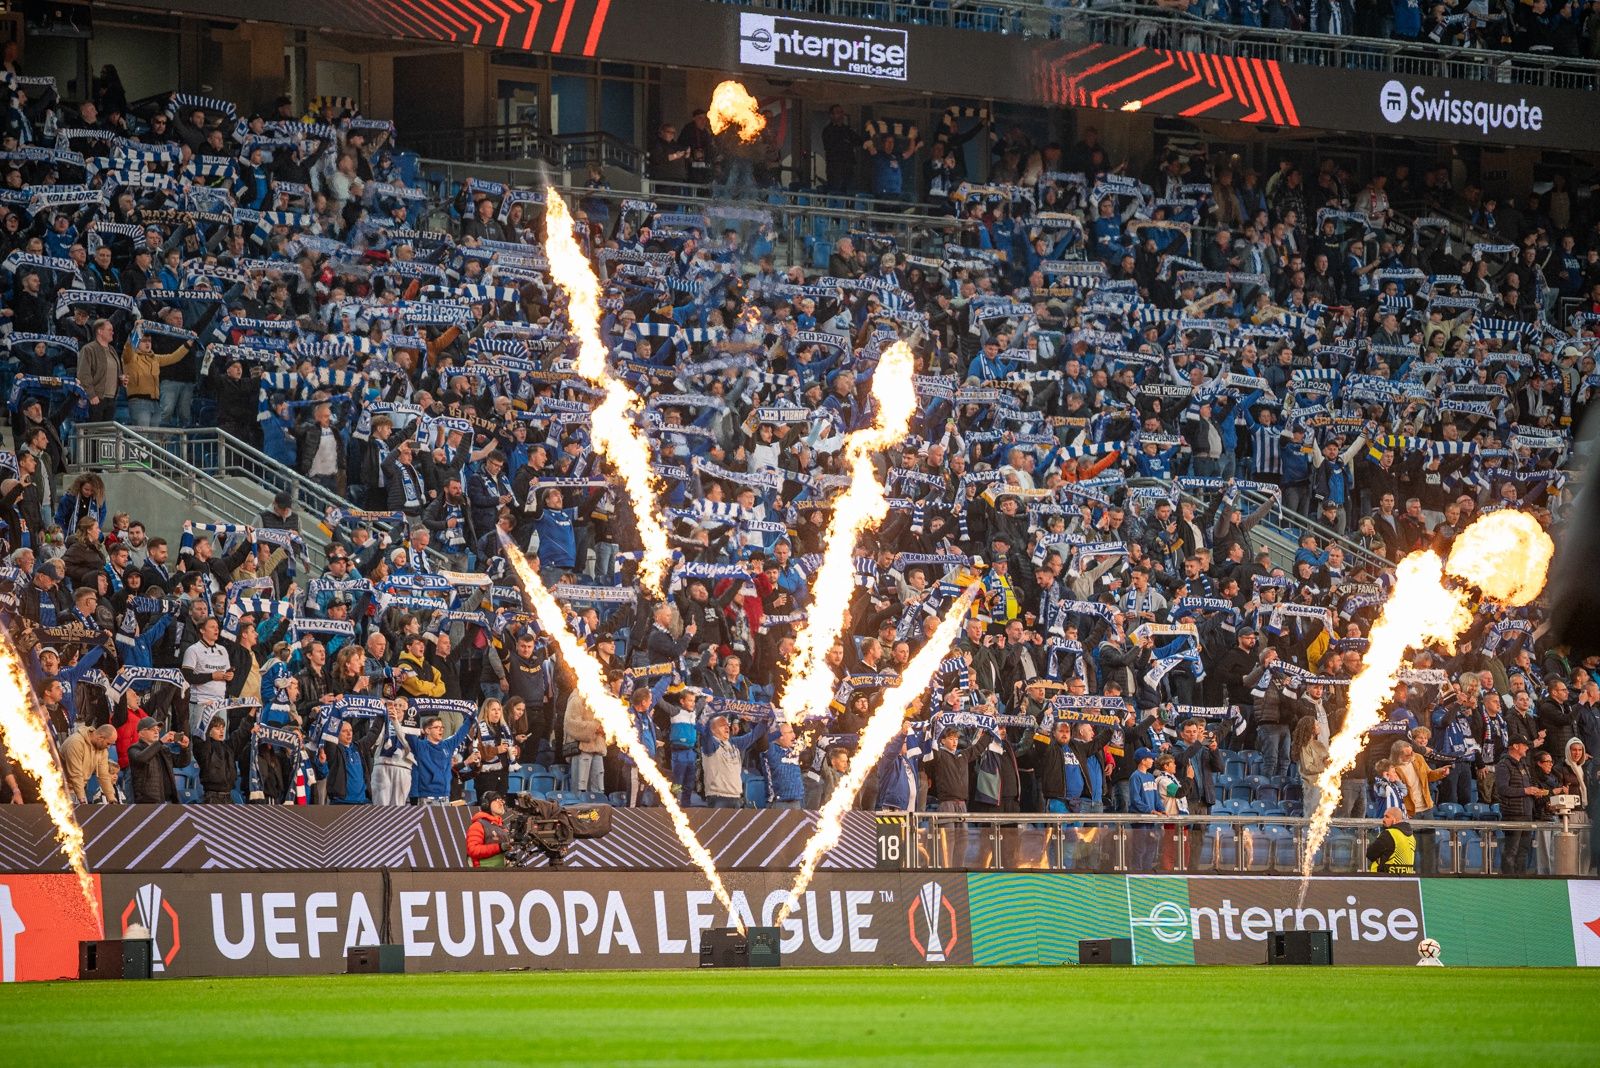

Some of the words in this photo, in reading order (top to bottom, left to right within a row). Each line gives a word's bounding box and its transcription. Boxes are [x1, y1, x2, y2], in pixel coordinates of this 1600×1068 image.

[1410, 85, 1543, 134] Swissquote
[115, 170, 168, 187] LECH
[47, 192, 97, 203] KOLEJORZ
[150, 289, 175, 299] LECH
[1141, 384, 1161, 395] LECH
[1183, 597, 1202, 607] LECH
[1057, 709, 1079, 719] LECH
[1190, 705, 1205, 714] LECH
[878, 835, 900, 861] 18
[211, 891, 380, 960] UEFA
[401, 890, 641, 957] EUROPA
[655, 890, 879, 956] LEAGUE
